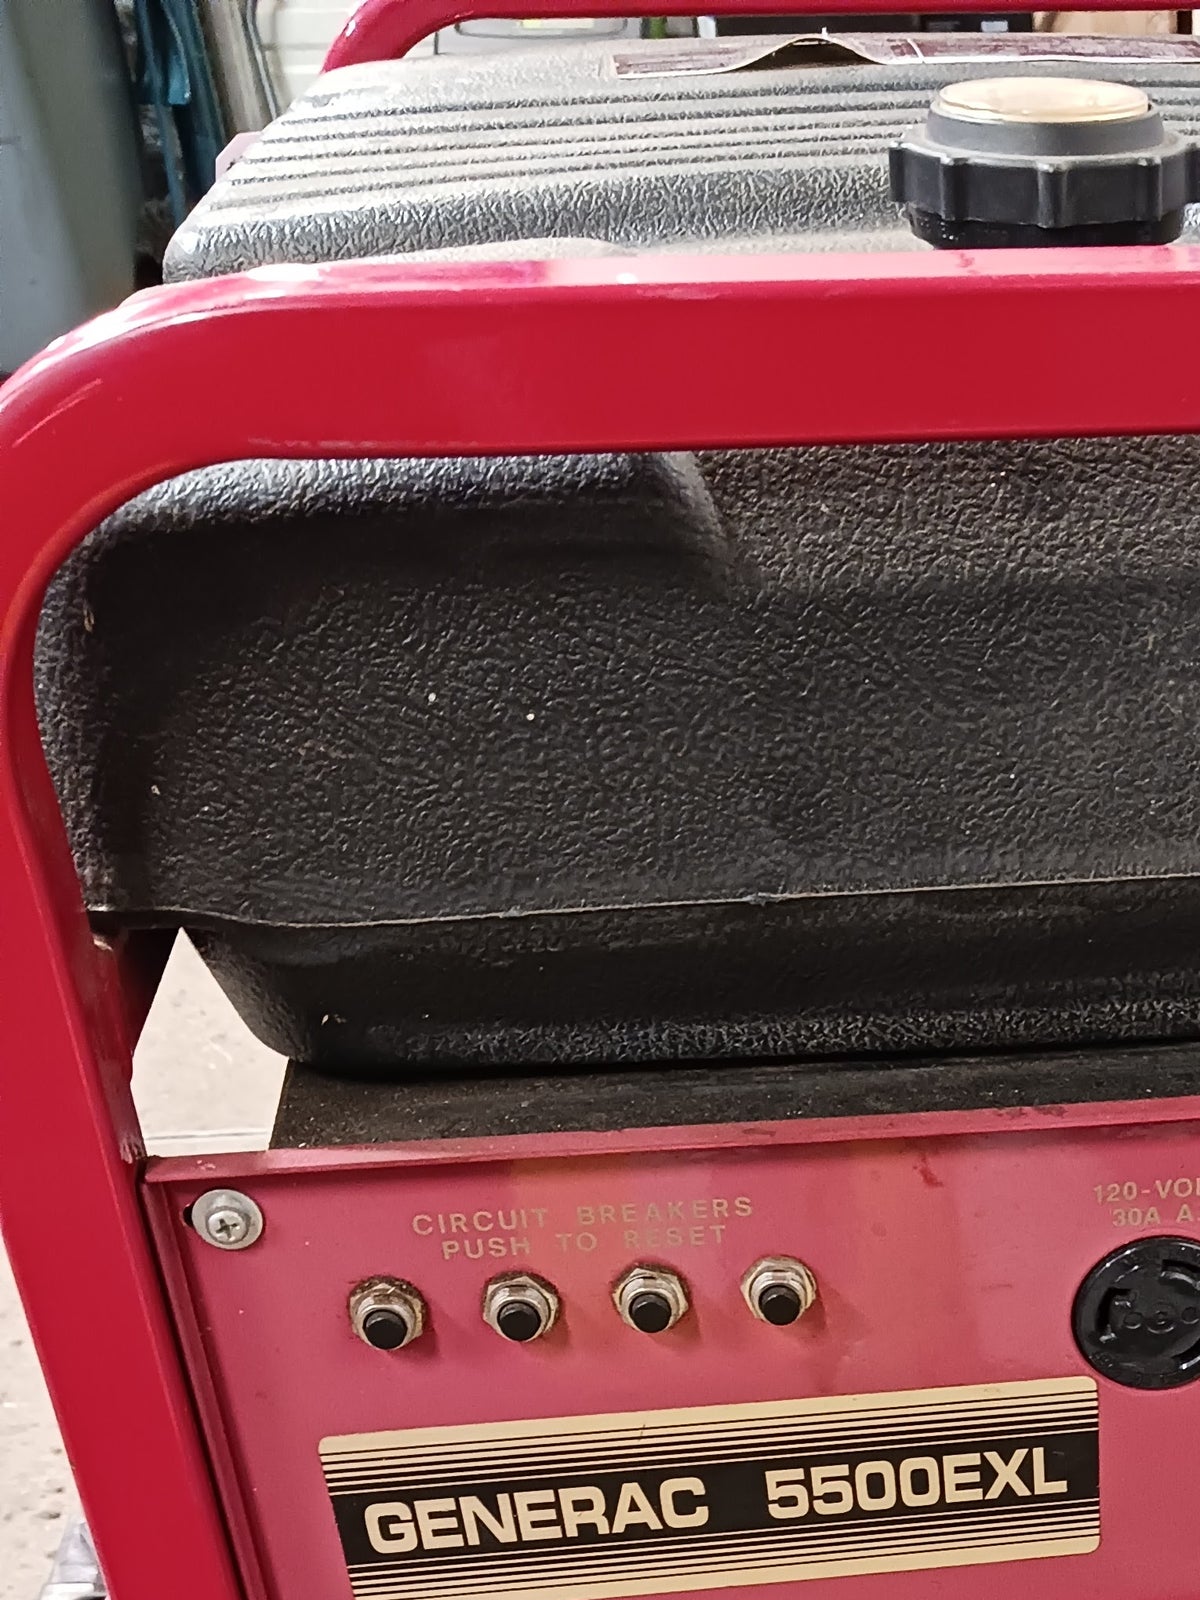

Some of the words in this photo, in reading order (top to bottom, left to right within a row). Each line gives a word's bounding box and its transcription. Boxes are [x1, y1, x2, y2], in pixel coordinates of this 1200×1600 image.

[411, 1207, 548, 1236] CIRCUIT
[577, 1196, 754, 1226] BREAKERS
[1112, 1205, 1161, 1227] 30A
[442, 1236, 531, 1260] PUSH
[555, 1232, 598, 1252] TO
[624, 1225, 727, 1248] RESET
[364, 1477, 710, 1555] GENERAC
[765, 1447, 1068, 1520] 5500EXL
